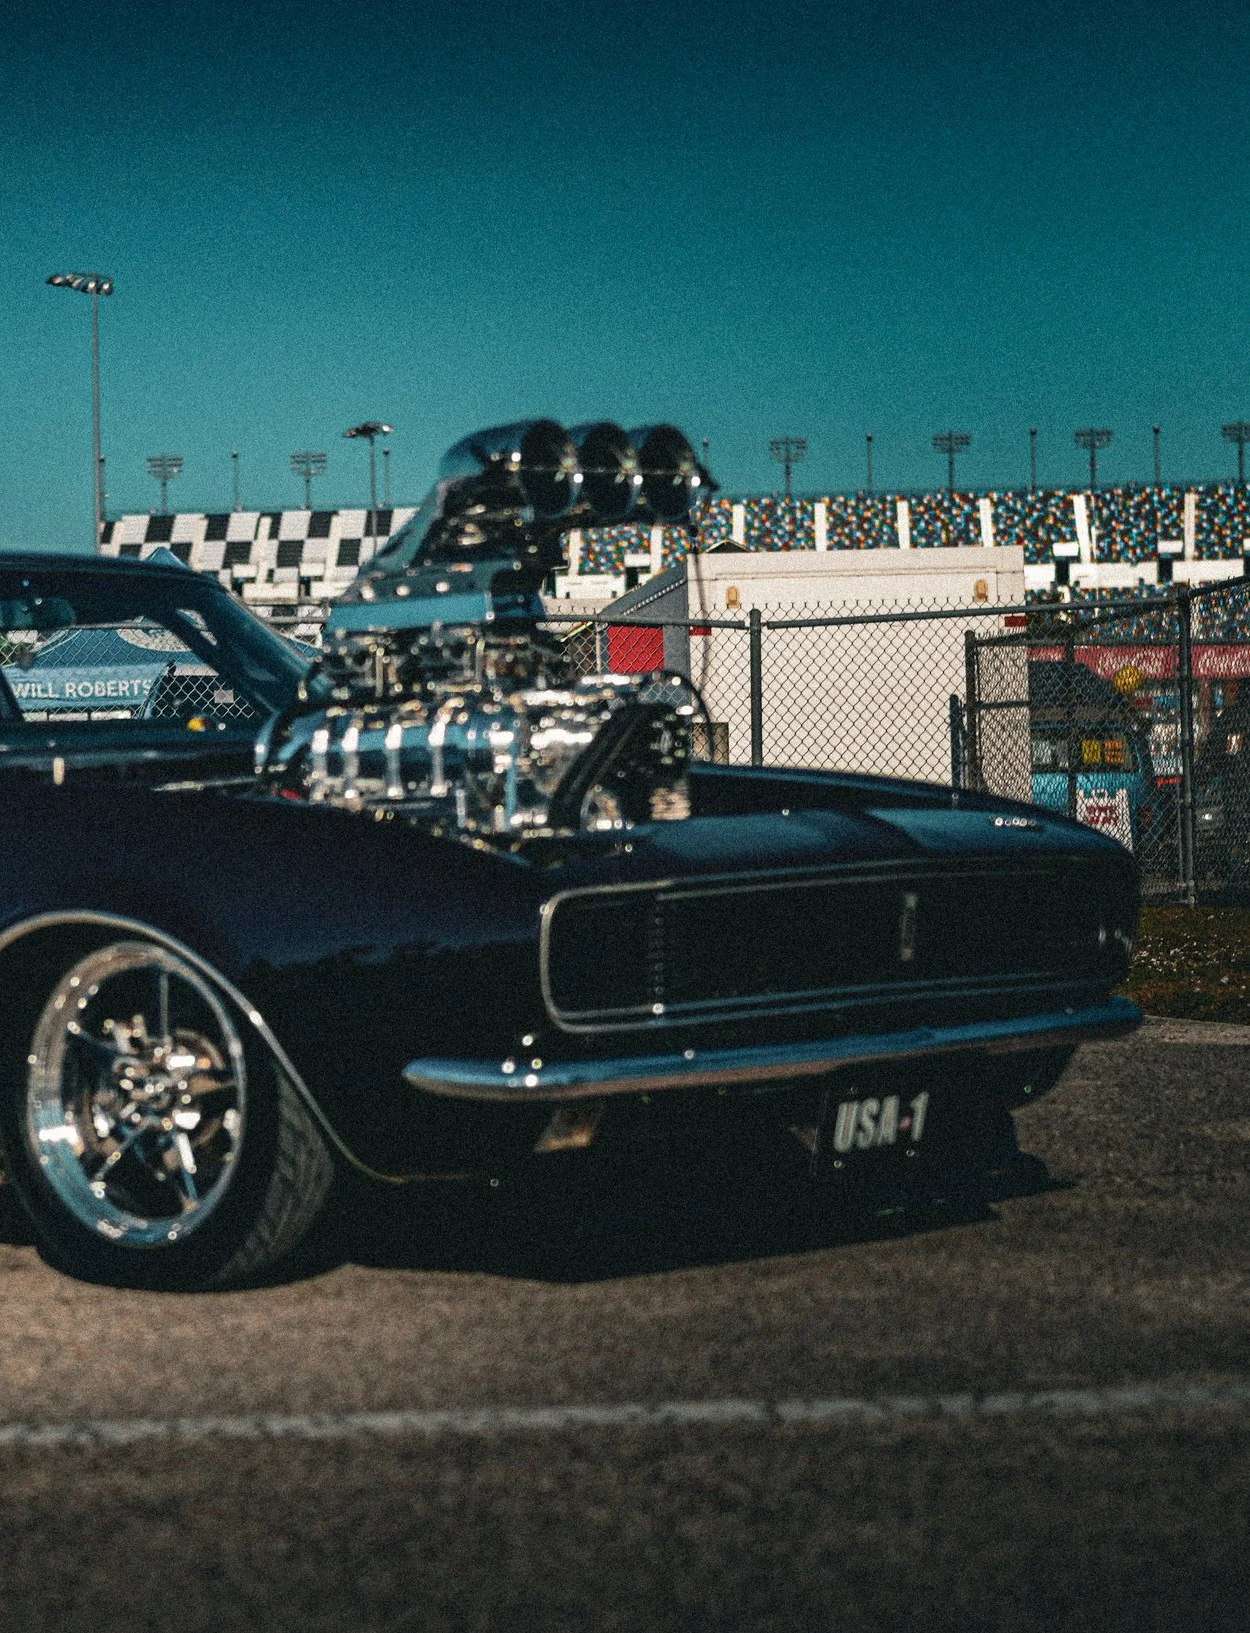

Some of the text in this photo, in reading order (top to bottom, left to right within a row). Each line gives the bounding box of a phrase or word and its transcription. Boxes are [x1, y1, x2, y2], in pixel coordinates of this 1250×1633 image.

[12, 679, 152, 698] WILL ROBERTS
[833, 1090, 930, 1152] USA-1
